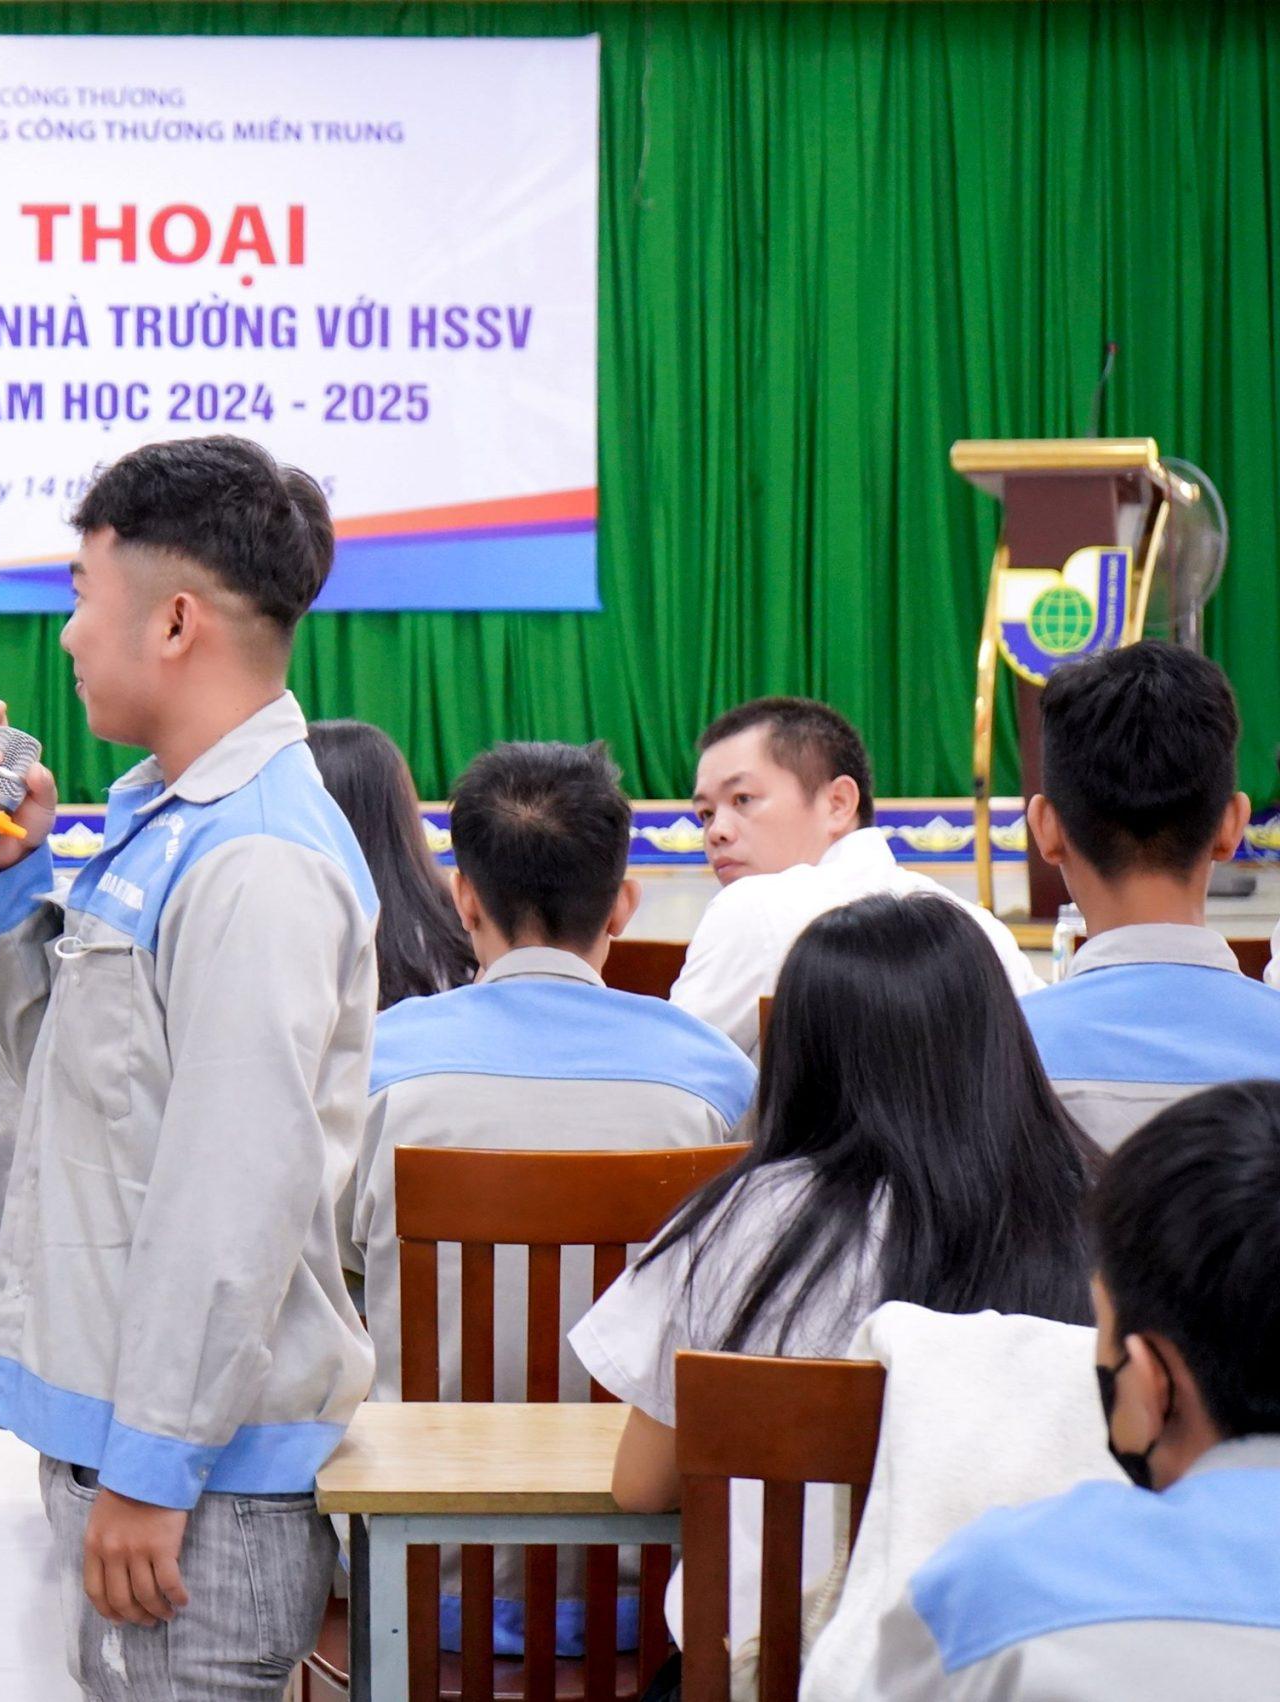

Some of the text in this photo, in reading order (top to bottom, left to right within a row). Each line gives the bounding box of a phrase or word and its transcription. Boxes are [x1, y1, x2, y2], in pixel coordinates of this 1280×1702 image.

[76, 86, 185, 108] THƯƠNG
[17, 116, 97, 141] CÔNG
[104, 118, 223, 141] THƯƠNG
[311, 119, 406, 142] TRUNG
[21, 204, 306, 287] THOẠI
[108, 294, 298, 349] TRƯỜNG
[316, 295, 391, 349] VỚI
[409, 305, 533, 350] HSSV
[62, 382, 150, 431] HỌC
[167, 382, 275, 423] 2024
[323, 382, 430, 423] 2025
[24, 475, 56, 499] 14
